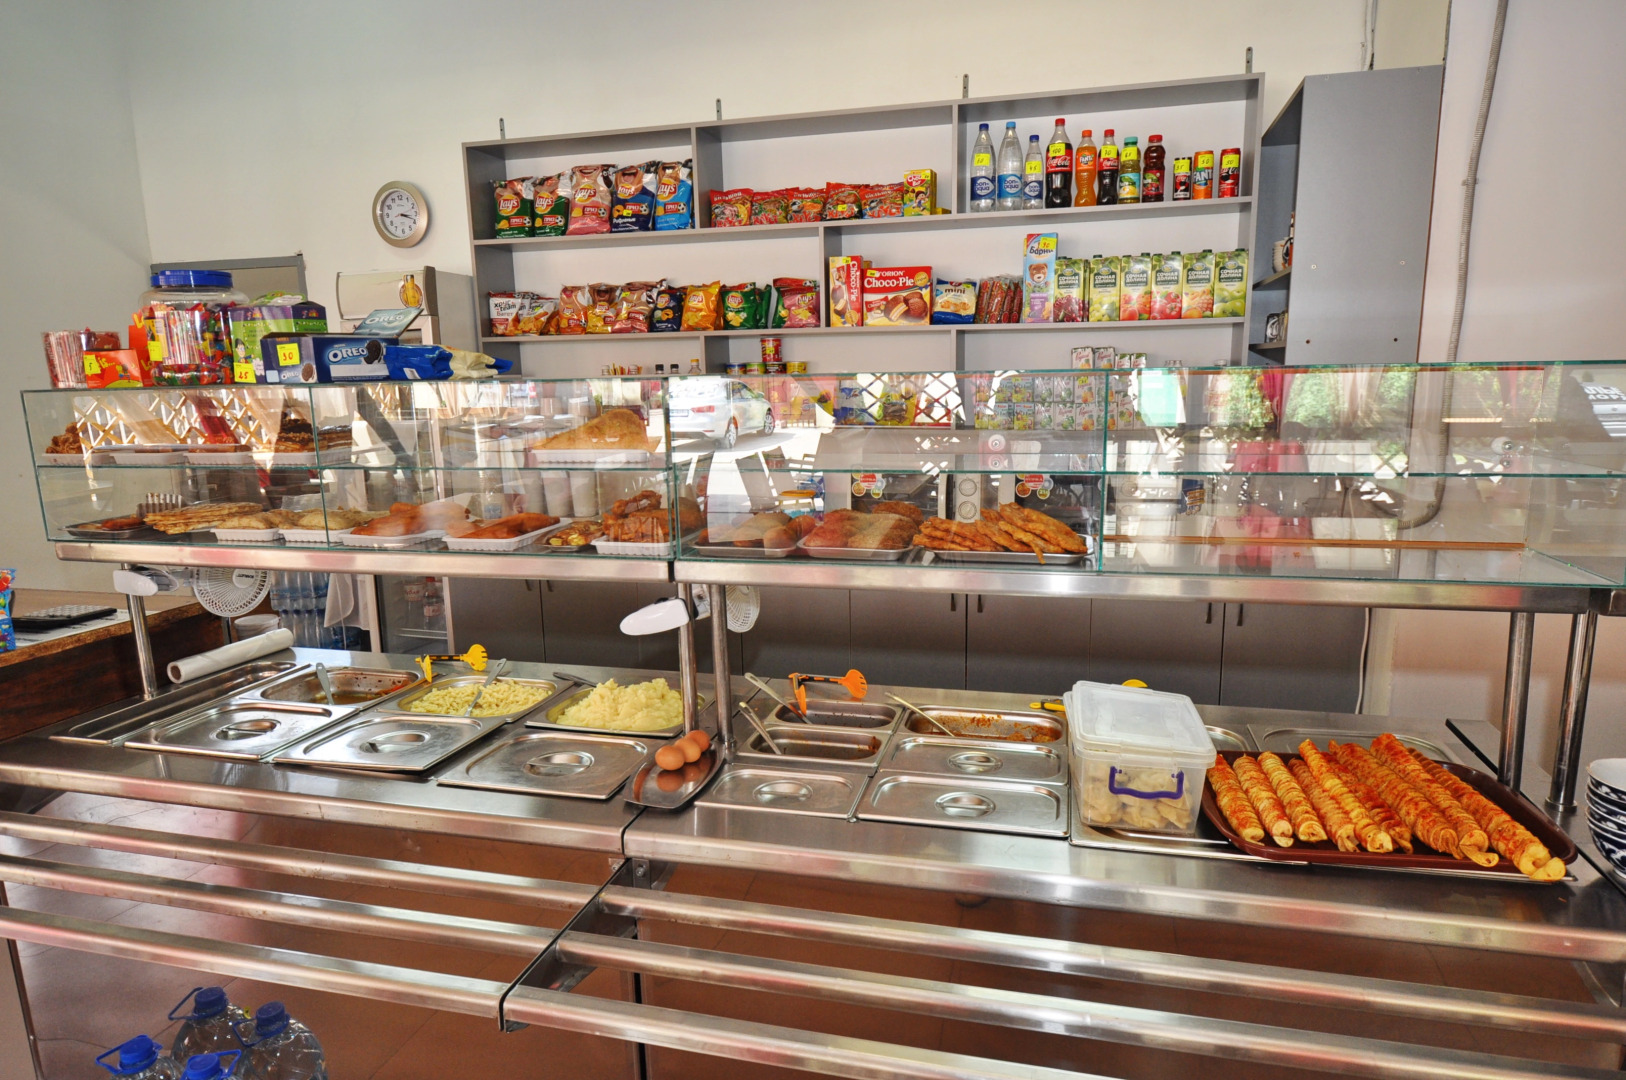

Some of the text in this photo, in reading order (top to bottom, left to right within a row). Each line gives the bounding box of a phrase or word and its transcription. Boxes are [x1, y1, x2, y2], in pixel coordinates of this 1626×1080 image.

[864, 276, 914, 288] Choco-Pie
[944, 286, 966, 294] mini
[365, 314, 404, 324] OREO
[328, 347, 368, 362] OREO
